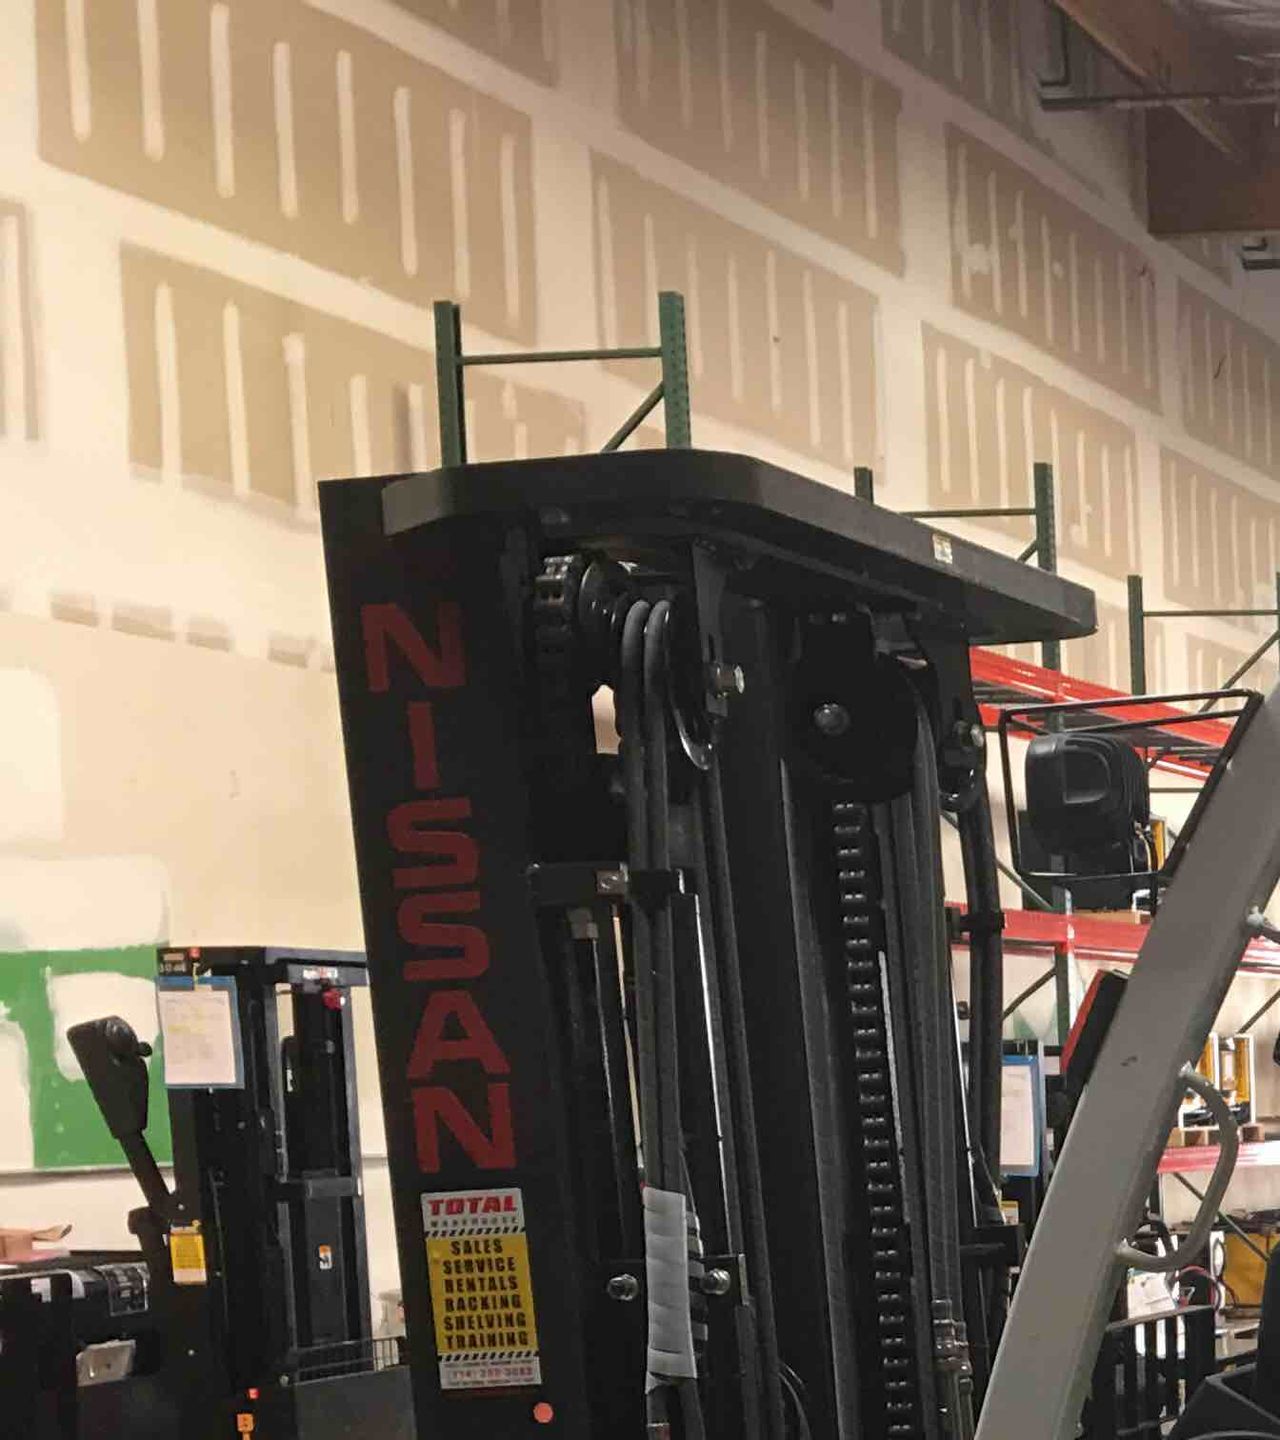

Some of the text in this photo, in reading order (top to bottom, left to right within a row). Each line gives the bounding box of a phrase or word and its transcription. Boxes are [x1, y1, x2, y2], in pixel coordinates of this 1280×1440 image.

[360, 602, 517, 1173] NISSAN
[428, 1195, 518, 1217] TOTAL
[451, 1238, 504, 1256] SALES
[442, 1256, 516, 1276] SERVICE
[443, 1275, 519, 1294] RENTALS
[444, 1294, 523, 1313] RACKING
[443, 1311, 527, 1332] SHELVING
[444, 1329, 530, 1351] TRAINING
